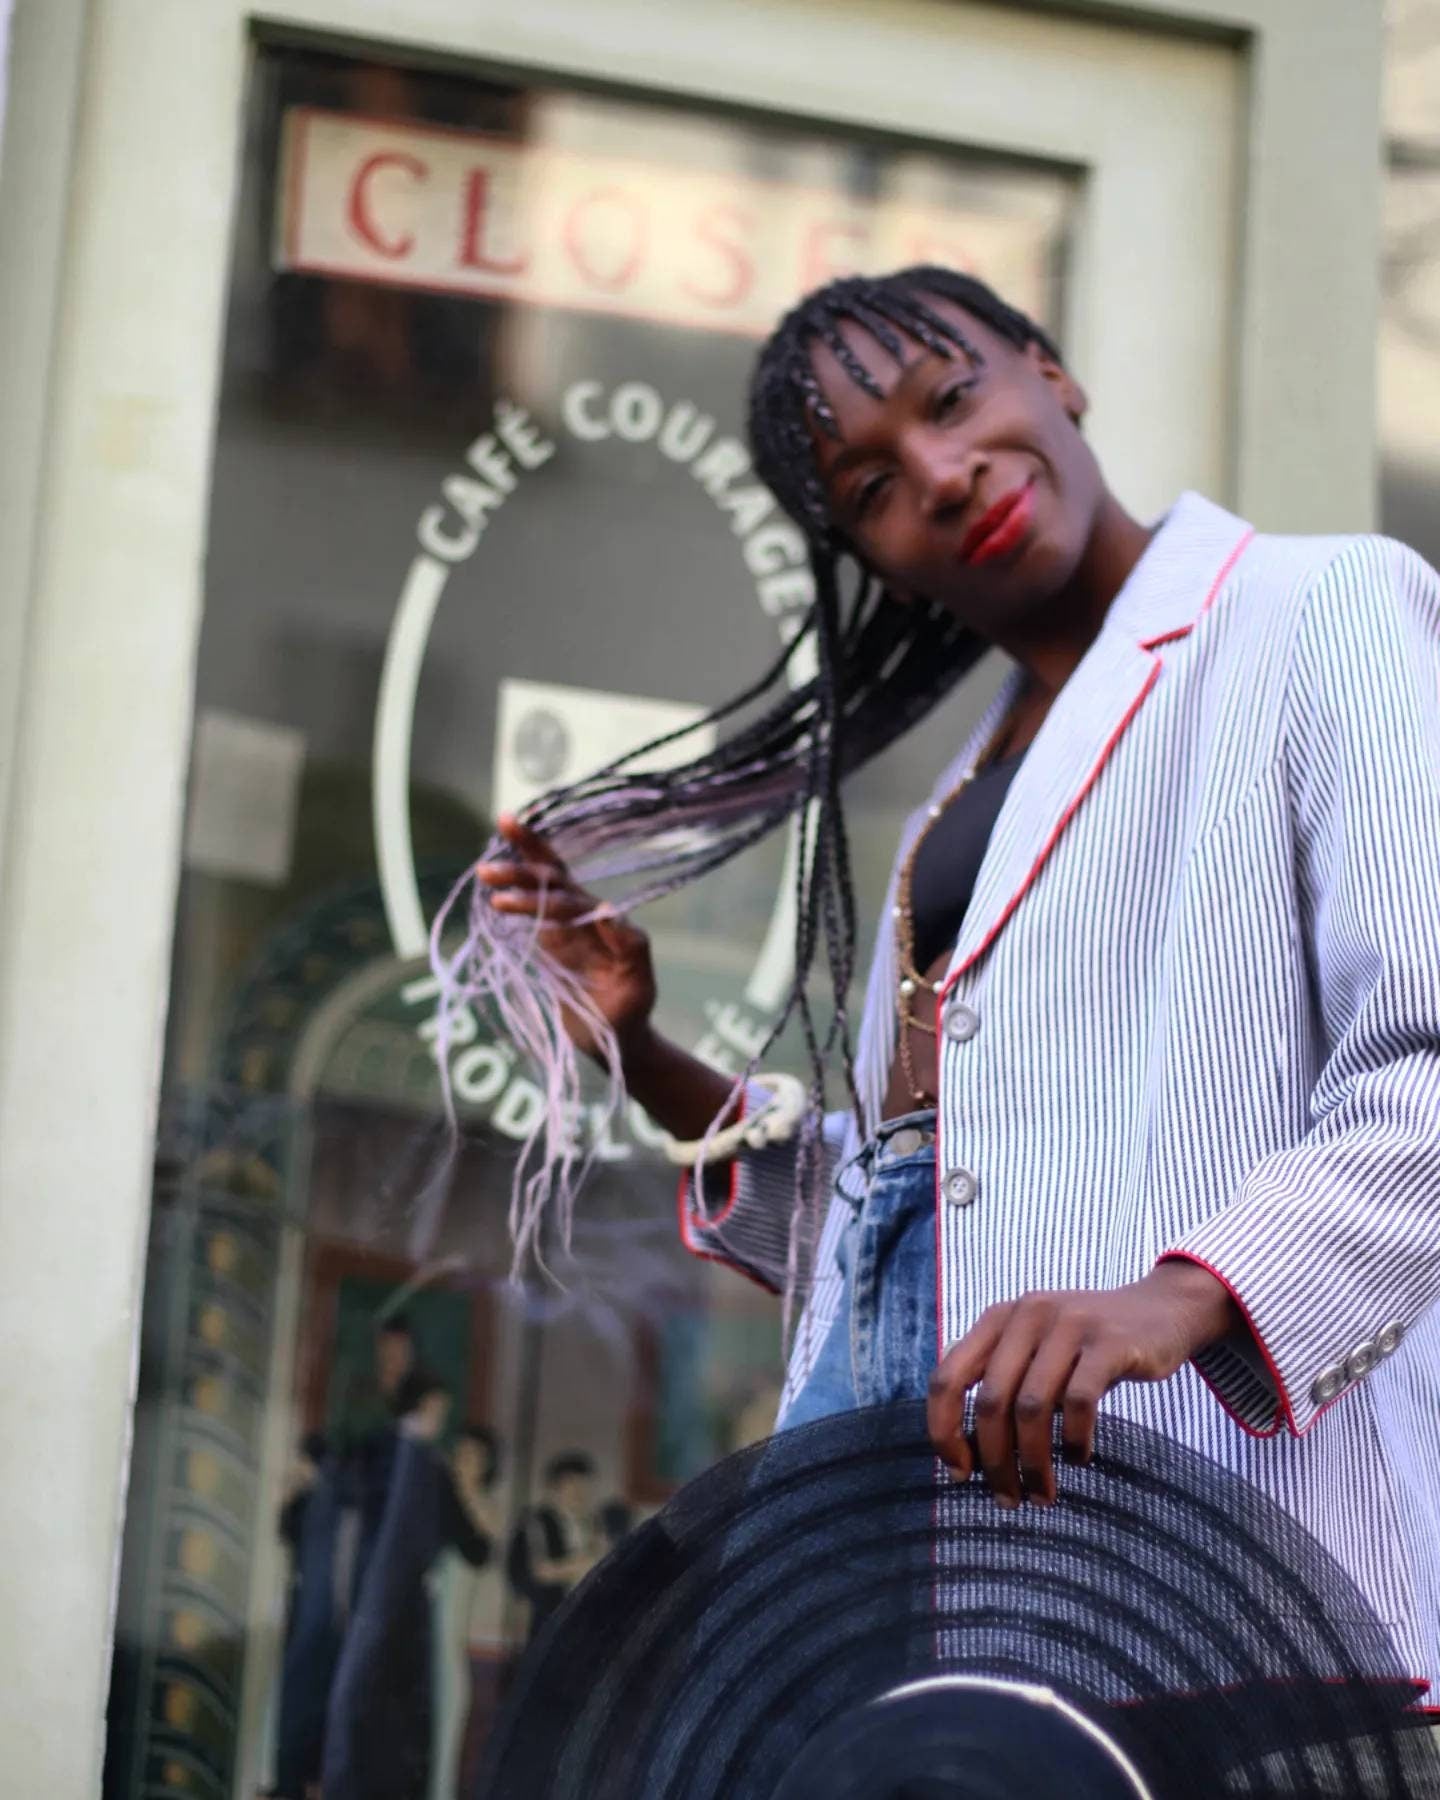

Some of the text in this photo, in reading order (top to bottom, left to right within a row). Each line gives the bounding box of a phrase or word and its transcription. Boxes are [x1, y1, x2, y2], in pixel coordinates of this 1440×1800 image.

[347, 152, 978, 312] CLOSE
[417, 380, 817, 616] CAFÉ COURAGE
[402, 962, 774, 1161] TRÖDELCFÉ
